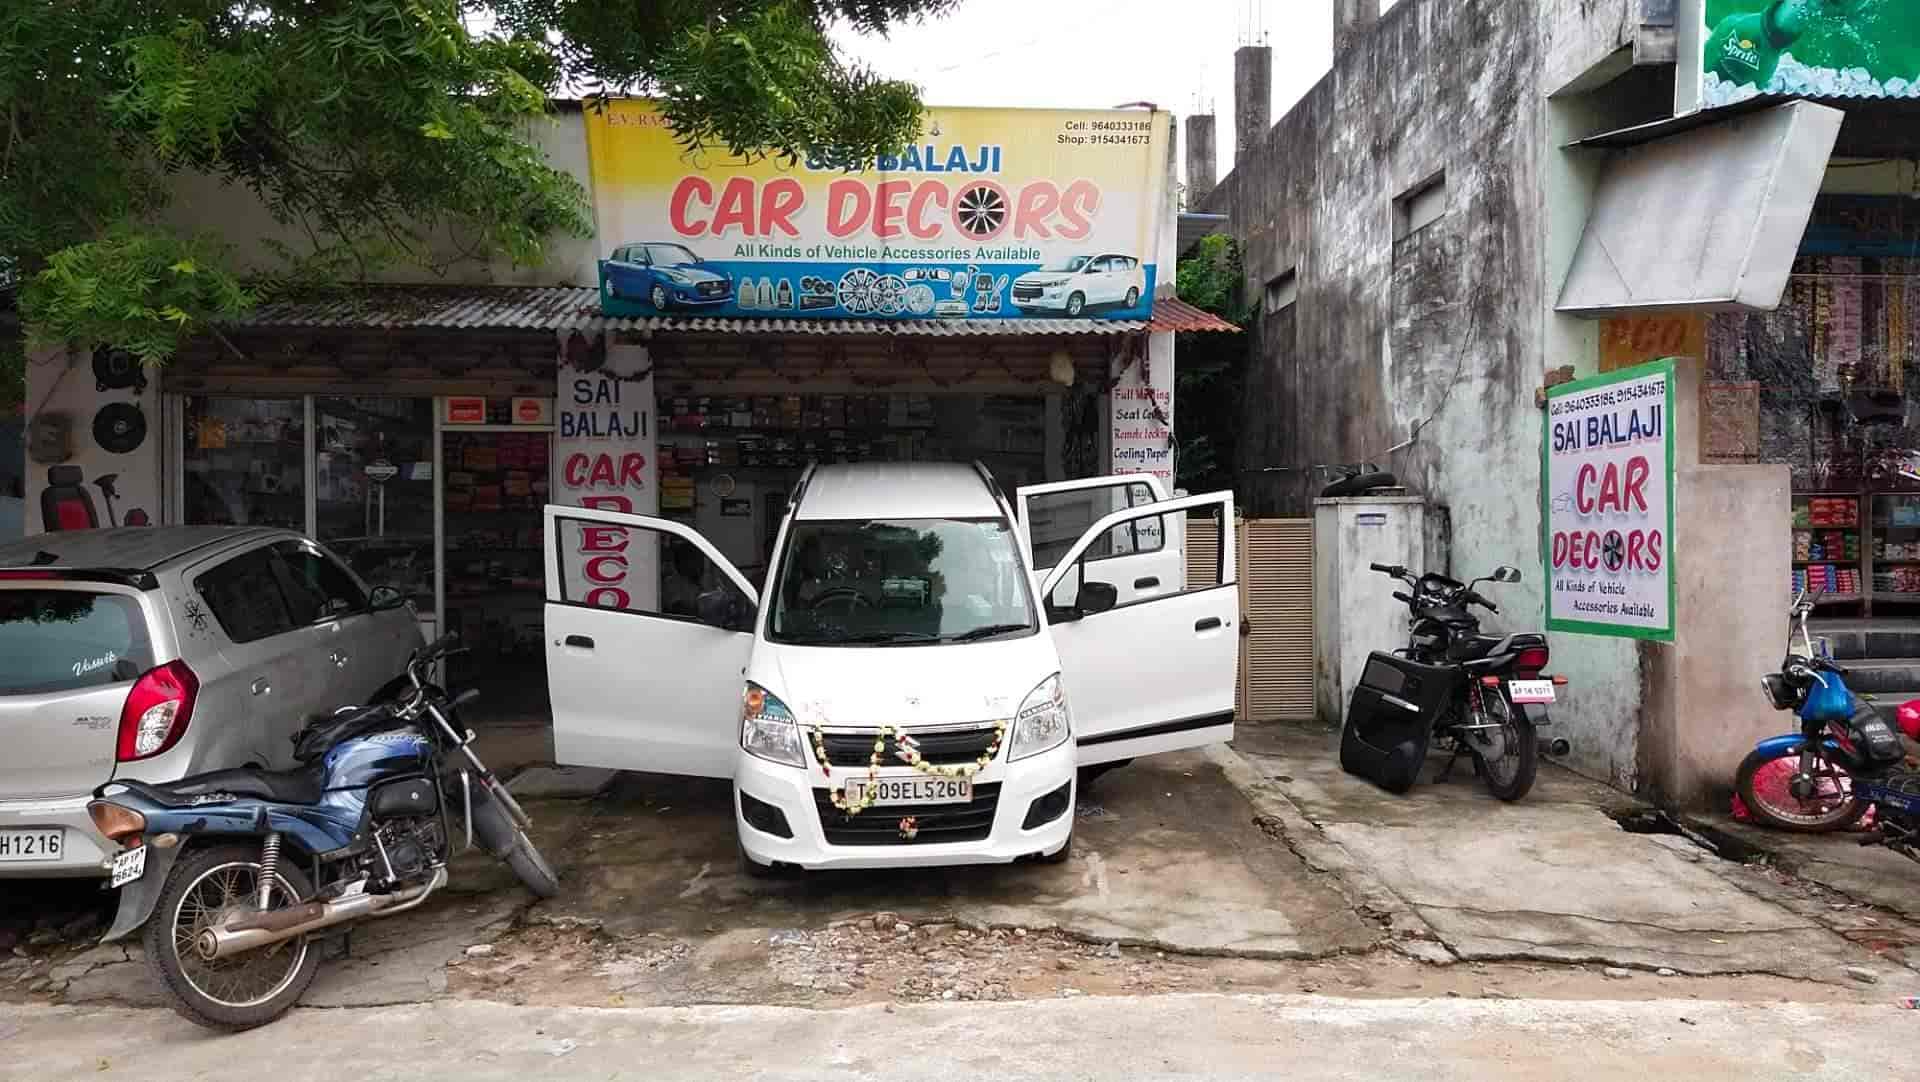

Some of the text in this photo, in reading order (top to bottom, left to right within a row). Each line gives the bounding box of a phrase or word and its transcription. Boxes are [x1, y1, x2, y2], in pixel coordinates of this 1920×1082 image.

[1723, 38, 1758, 63] Sprite
[1091, 121, 1151, 131] 9640333186
[1057, 134, 1150, 145] Shop: 9154341673
[877, 144, 1001, 173] BALAJI
[670, 176, 1102, 241] CAR DECORS
[734, 243, 1041, 261] All Kinds of Vehicle Accessories Available
[574, 380, 621, 404] SAI
[561, 411, 648, 438] BALAJI
[1553, 404, 1662, 452] SAI BALAJI
[1114, 447, 1144, 464] Cooling
[565, 453, 646, 487] CAR
[1576, 455, 1650, 515] CAR
[1553, 528, 1662, 572] DECORS
[1598, 581, 1626, 595] Vehicle
[1573, 600, 1655, 618] Accessories Available
[0, 835, 60, 855] H1216
